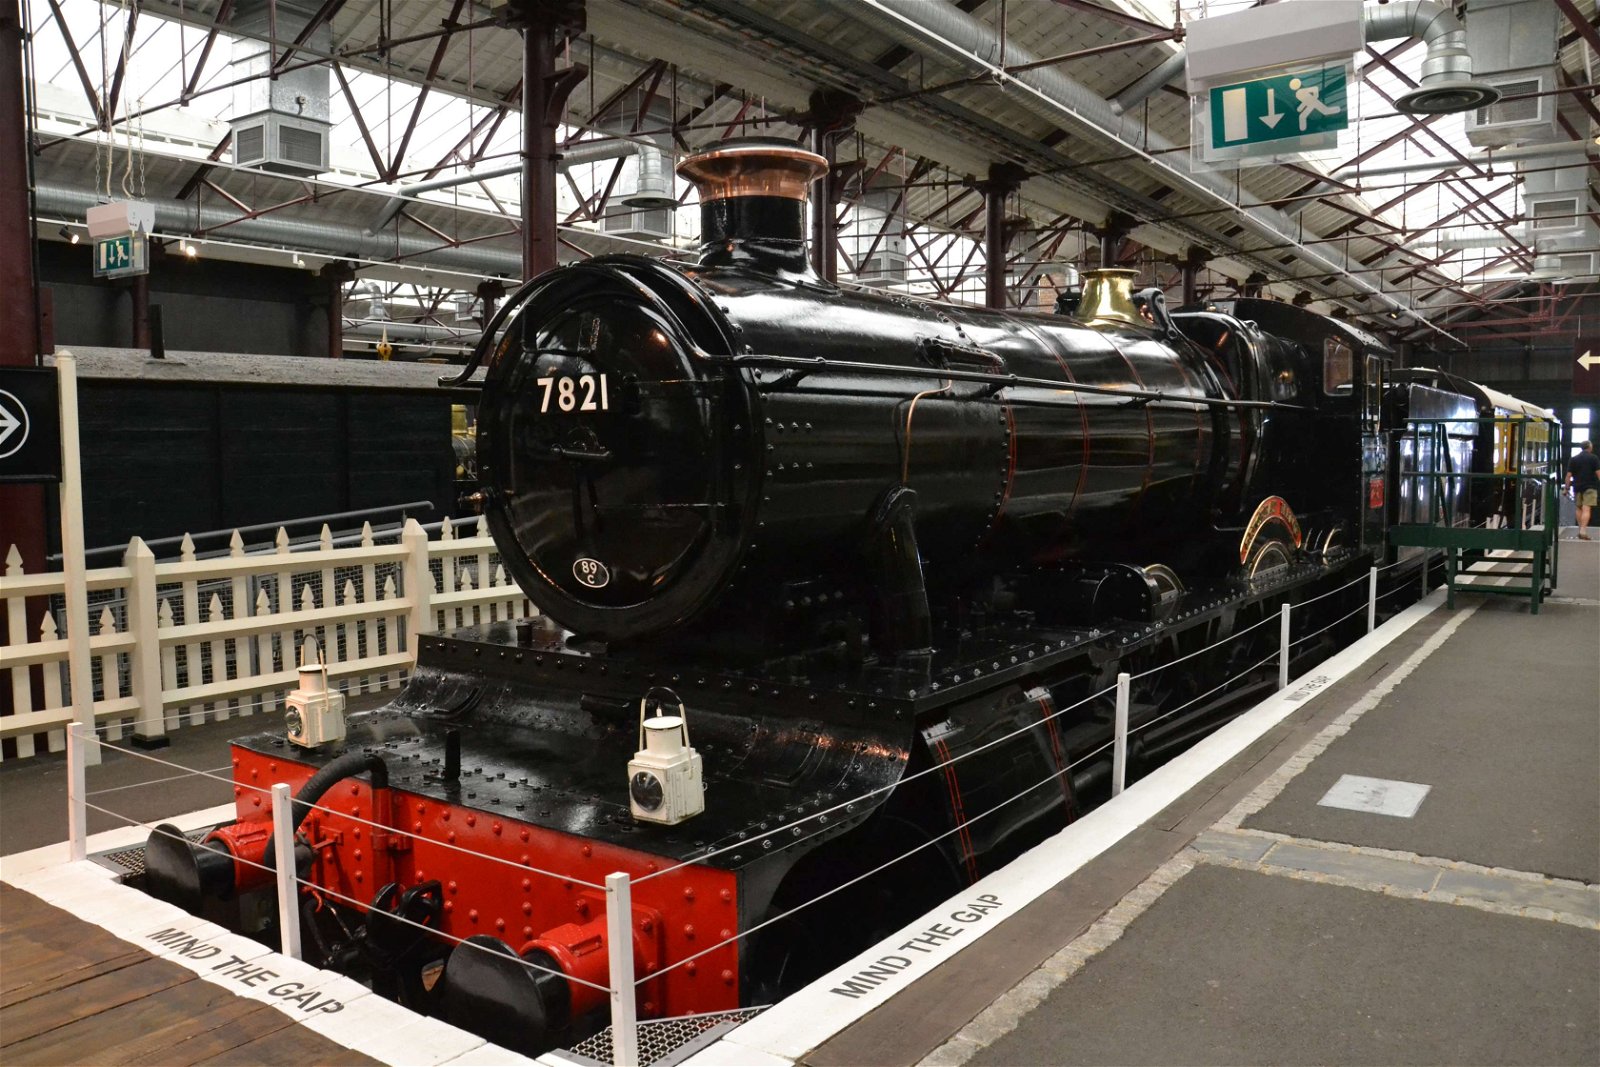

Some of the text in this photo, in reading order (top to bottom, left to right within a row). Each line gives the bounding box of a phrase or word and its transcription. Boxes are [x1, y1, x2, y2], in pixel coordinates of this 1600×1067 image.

[537, 373, 609, 413] 7821
[581, 560, 597, 574] 89
[587, 574, 596, 585] C
[829, 894, 1003, 999] MIND THE GAP
[146, 927, 345, 1014] MIND THE GAP
